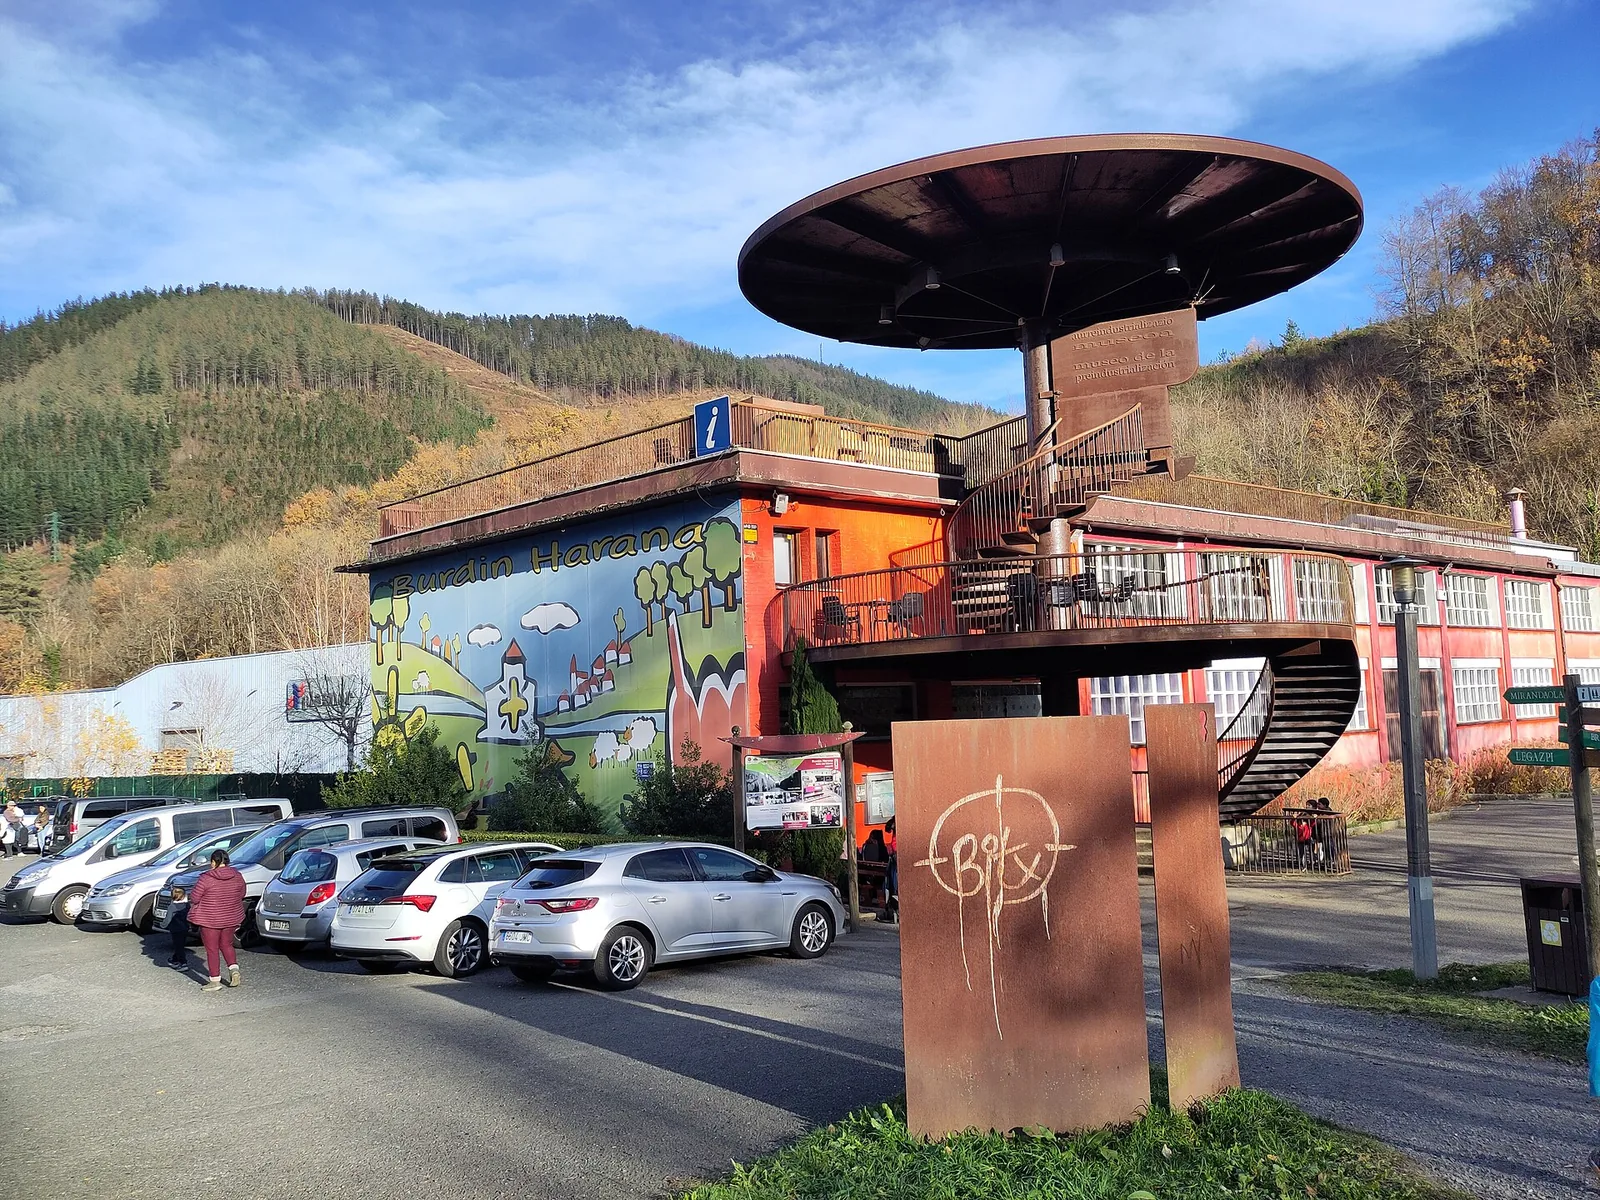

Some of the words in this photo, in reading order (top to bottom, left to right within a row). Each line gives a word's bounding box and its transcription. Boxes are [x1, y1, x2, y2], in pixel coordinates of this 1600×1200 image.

[1072, 329, 1175, 351] museoa
[1073, 356, 1129, 371] museo
[1134, 350, 1156, 363] de
[1159, 347, 1176, 358] la
[1075, 360, 1175, 383] preindustrialización
[393, 554, 513, 598] Burdin
[530, 522, 705, 574] Harana
[1510, 690, 1564, 700] MIRANDAOLA
[1515, 751, 1554, 762] LEGAZPI
